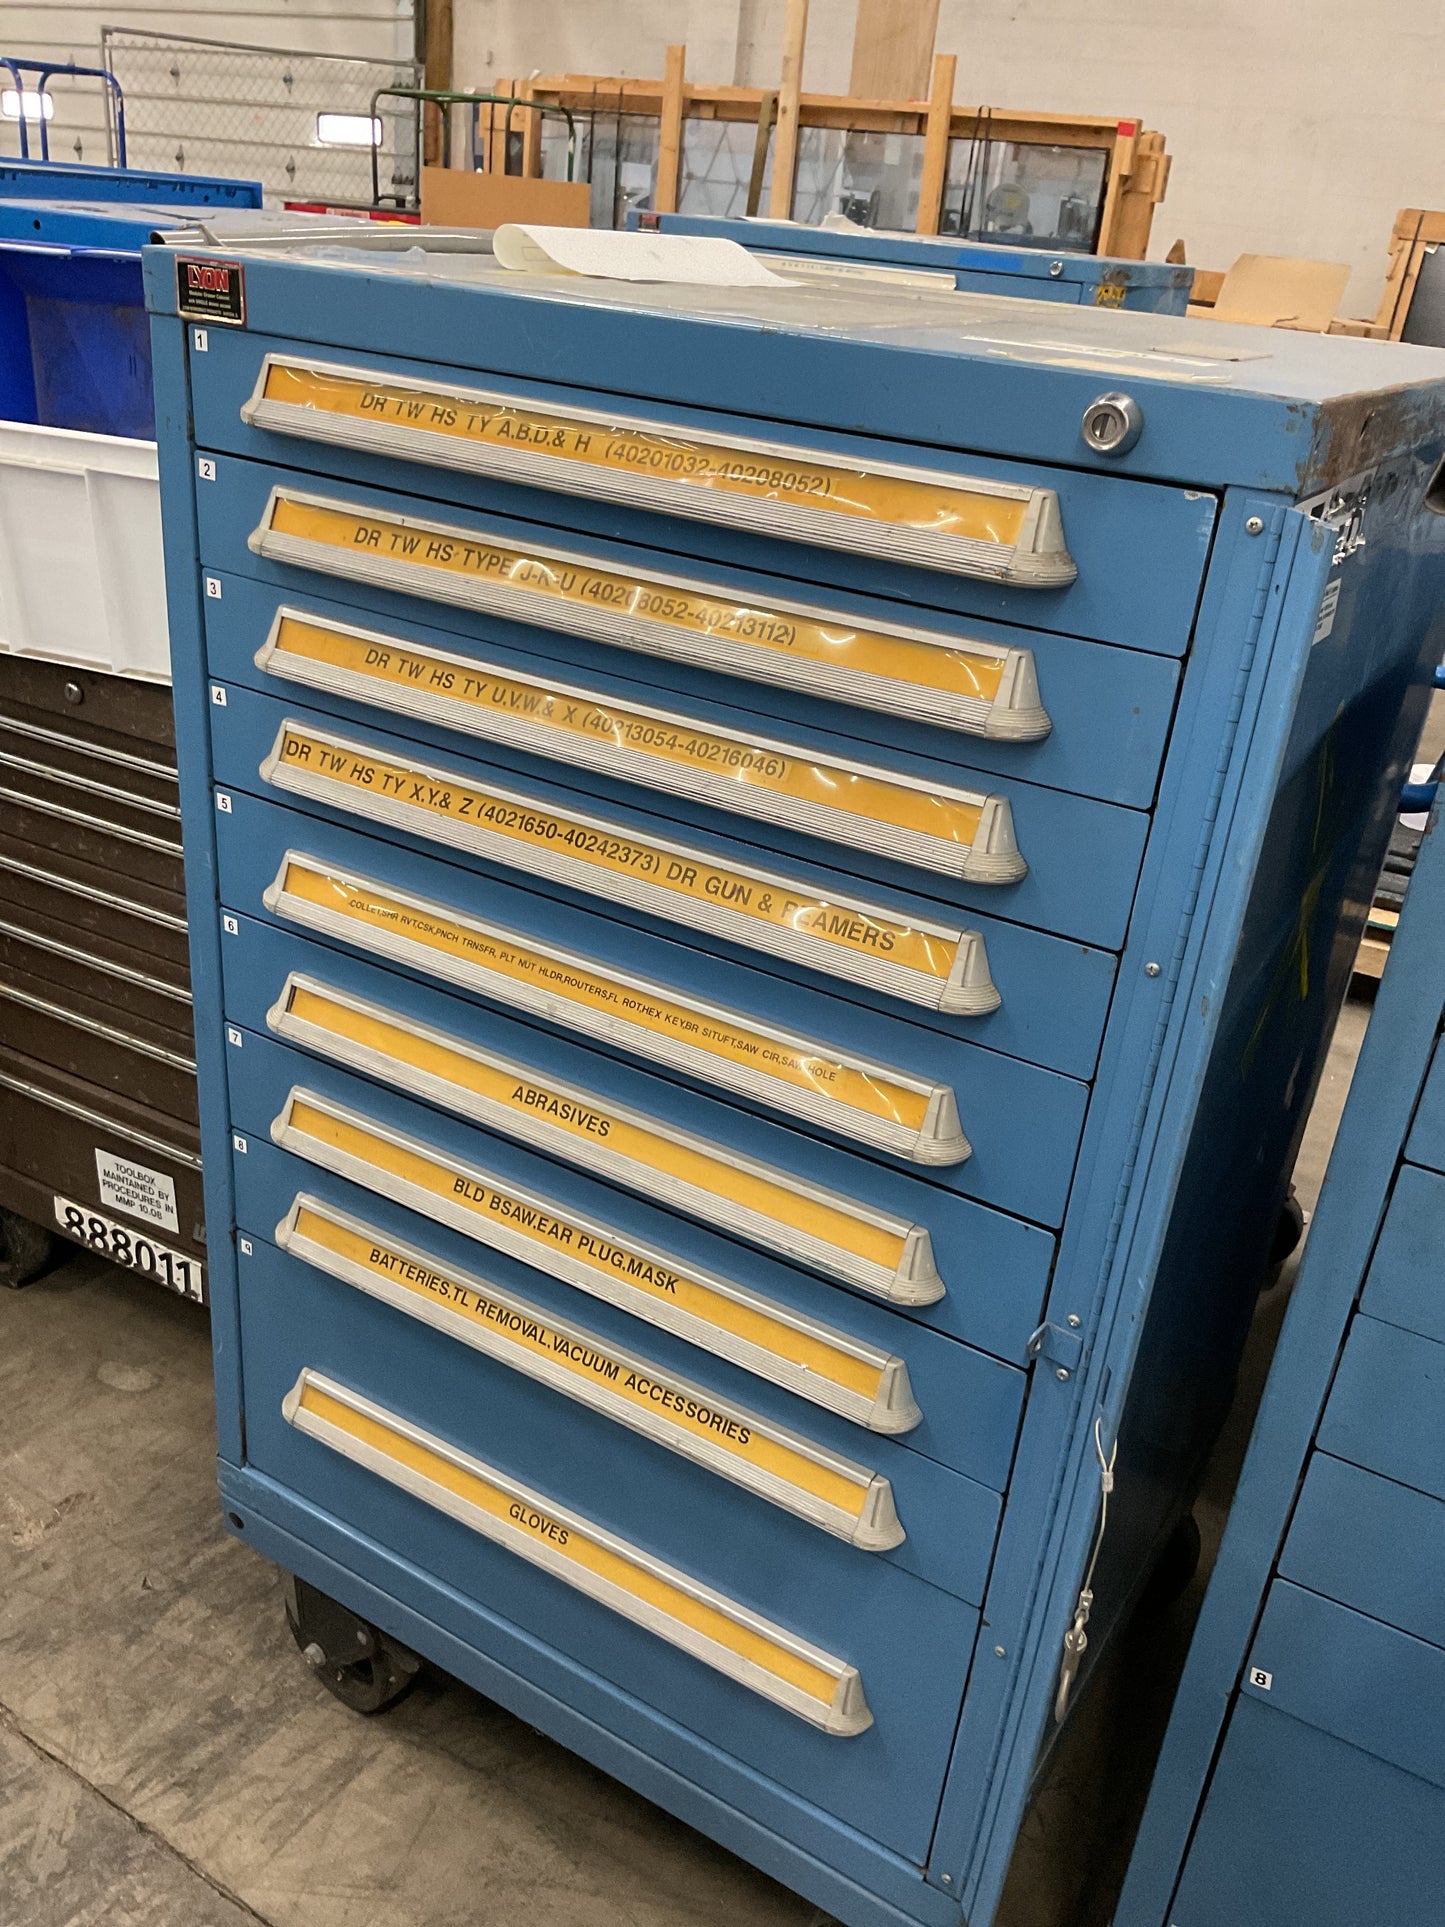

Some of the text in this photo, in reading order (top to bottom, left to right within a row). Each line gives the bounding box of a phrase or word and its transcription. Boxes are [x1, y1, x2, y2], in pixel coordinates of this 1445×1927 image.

[188, 265, 229, 292] LYON
[197, 334, 203, 348] 1
[360, 392, 387, 412] DR
[395, 400, 425, 419] TW
[431, 406, 458, 426] HS
[467, 414, 492, 432] TY
[575, 434, 591, 453] H
[204, 463, 211, 477] 2
[354, 527, 382, 547] DR
[390, 534, 421, 554] TW
[426, 542, 454, 562] HS
[463, 549, 514, 576] TYPE
[210, 582, 217, 595] 3
[216, 690, 223, 703] 4
[365, 648, 390, 669] DR
[398, 658, 425, 679] TW
[429, 669, 455, 689] HS
[463, 678, 488, 698] TY
[562, 705, 577, 724] X
[221, 797, 228, 810] 5
[285, 740, 312, 761] DR
[319, 751, 347, 772] TW
[350, 763, 375, 784] HS
[382, 774, 406, 794] TY
[459, 797, 474, 815] Z
[477, 802, 661, 874] (4021650-40242373)
[665, 862, 698, 887] DR
[704, 876, 753, 905] GUN
[757, 893, 773, 913] &
[228, 920, 234, 931] 6
[500, 951, 516, 964] PLT
[518, 958, 537, 972] NUT
[808, 1065, 836, 1081] HOLE
[232, 1032, 238, 1042] 7
[511, 1086, 610, 1136] ABRASIVES
[103, 1169, 169, 1201] MAINTAINED BY
[115, 1163, 155, 1185] TOOLBOX
[102, 1179, 174, 1214] PROCEDURES IN
[116, 1194, 135, 1208] MMP
[453, 1178, 485, 1203] BLD
[65, 1206, 192, 1294] 888011
[624, 1374, 751, 1444] ACCESSORIES
[509, 1503, 569, 1545] GLOVES
[1255, 1672, 1266, 1685] 8
